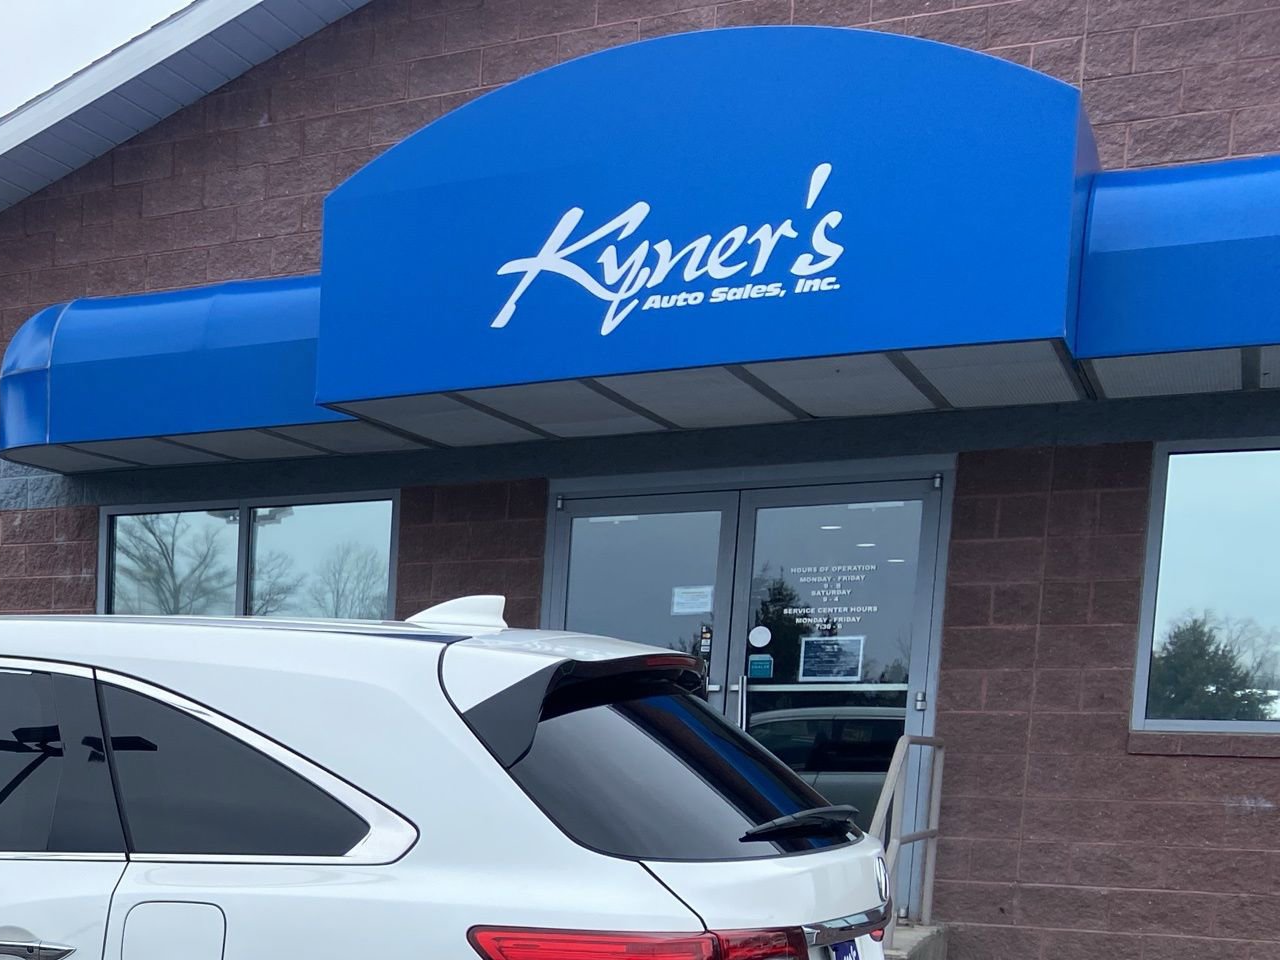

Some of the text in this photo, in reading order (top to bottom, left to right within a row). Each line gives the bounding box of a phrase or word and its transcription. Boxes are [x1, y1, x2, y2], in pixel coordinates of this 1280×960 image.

[490, 162, 845, 336] Kyner's
[642, 276, 841, 311] Auto Sales, Inc.
[831, 564, 876, 572] OPERATION
[783, 607, 816, 615] SERVICE
